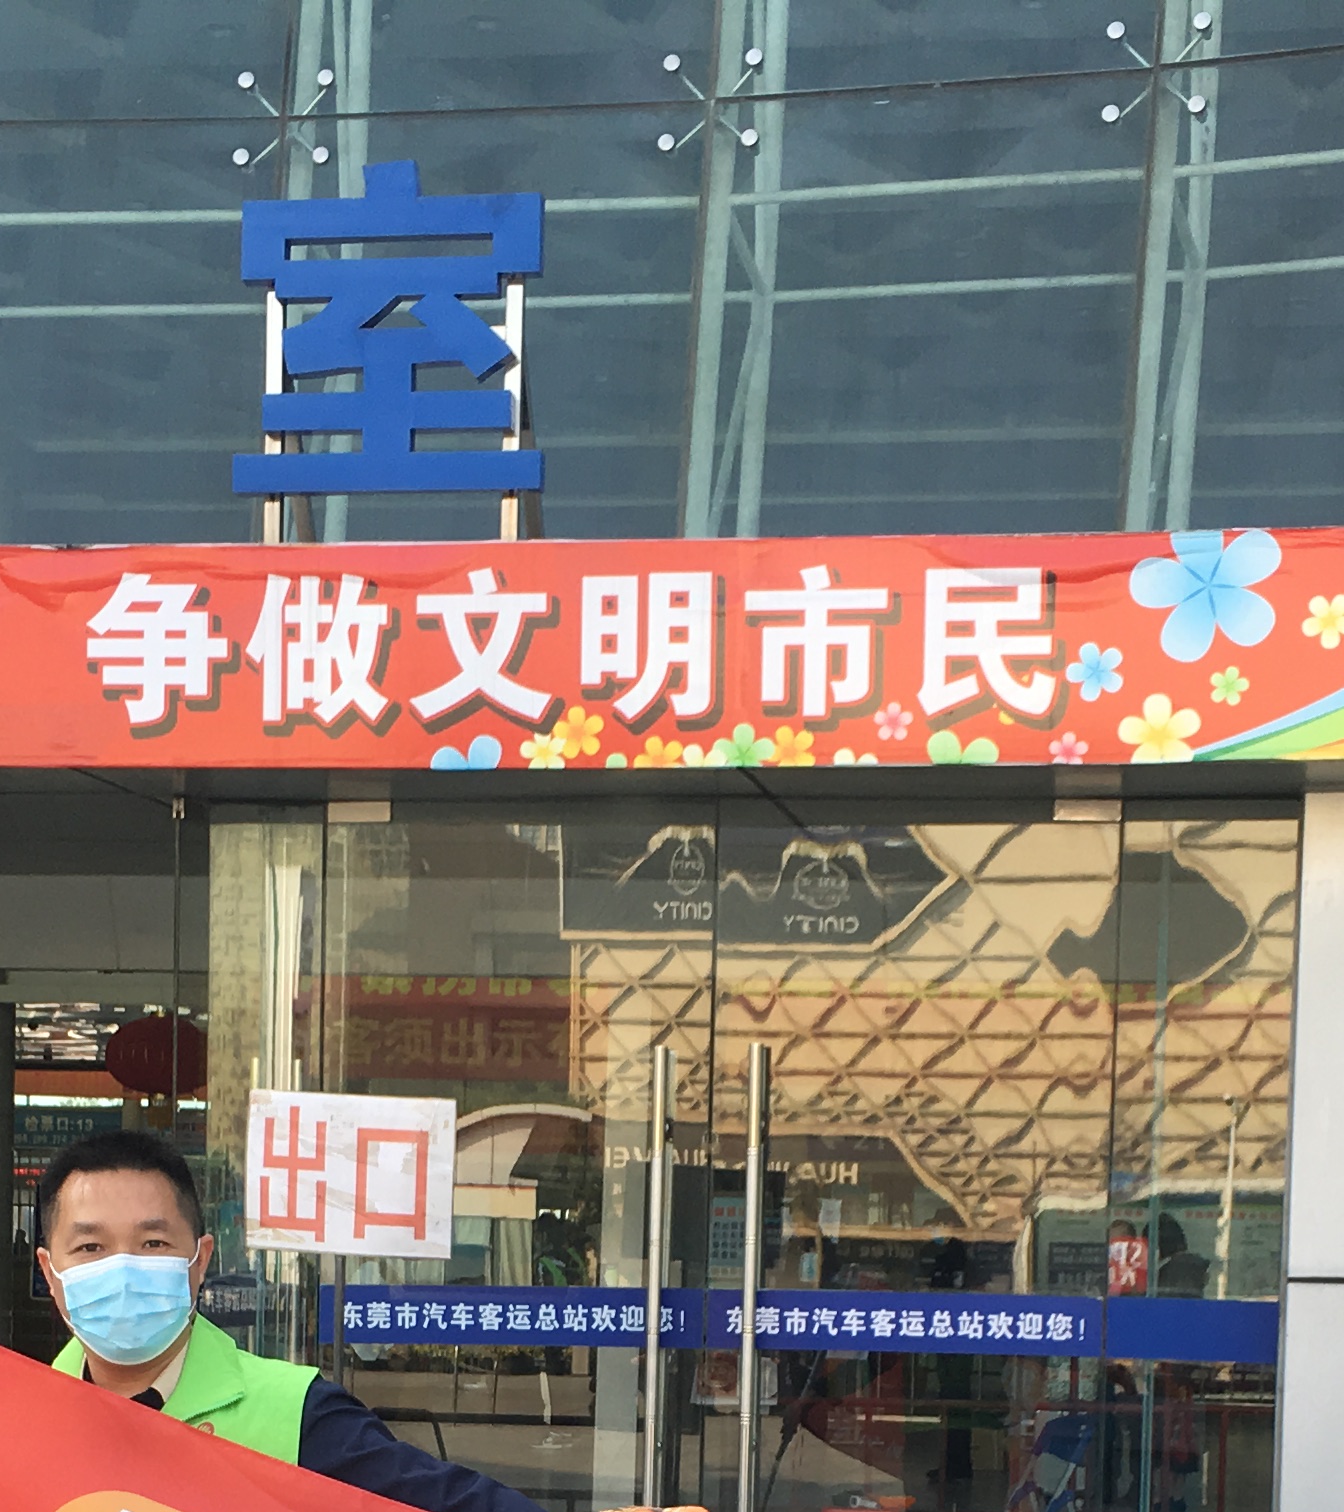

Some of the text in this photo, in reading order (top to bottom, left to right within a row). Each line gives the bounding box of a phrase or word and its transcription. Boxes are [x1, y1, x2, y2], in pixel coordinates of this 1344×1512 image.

[86, 563, 1061, 732] 争做文明市民
[259, 1105, 431, 1243] 出口
[726, 1306, 1085, 1342] 东莞市汽车客运总站欢迎您!
